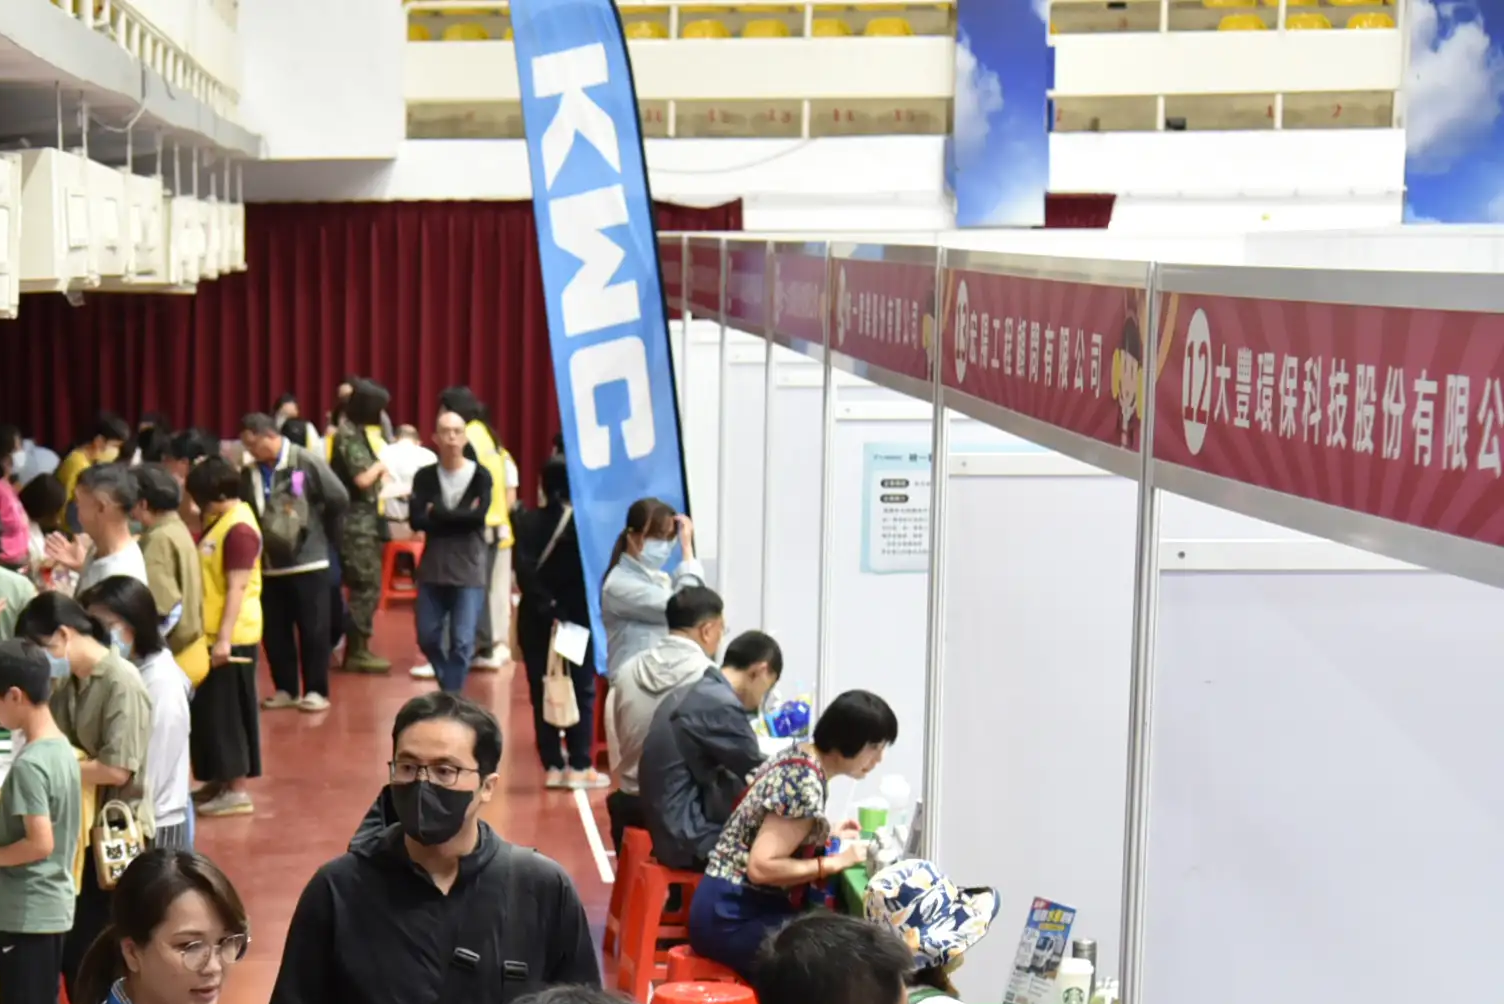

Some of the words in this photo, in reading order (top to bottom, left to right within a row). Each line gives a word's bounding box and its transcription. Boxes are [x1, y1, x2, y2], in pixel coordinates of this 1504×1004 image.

[1184, 340, 1208, 425] 12
[1214, 343, 1503, 479] 大豐環保科技股份有限公
